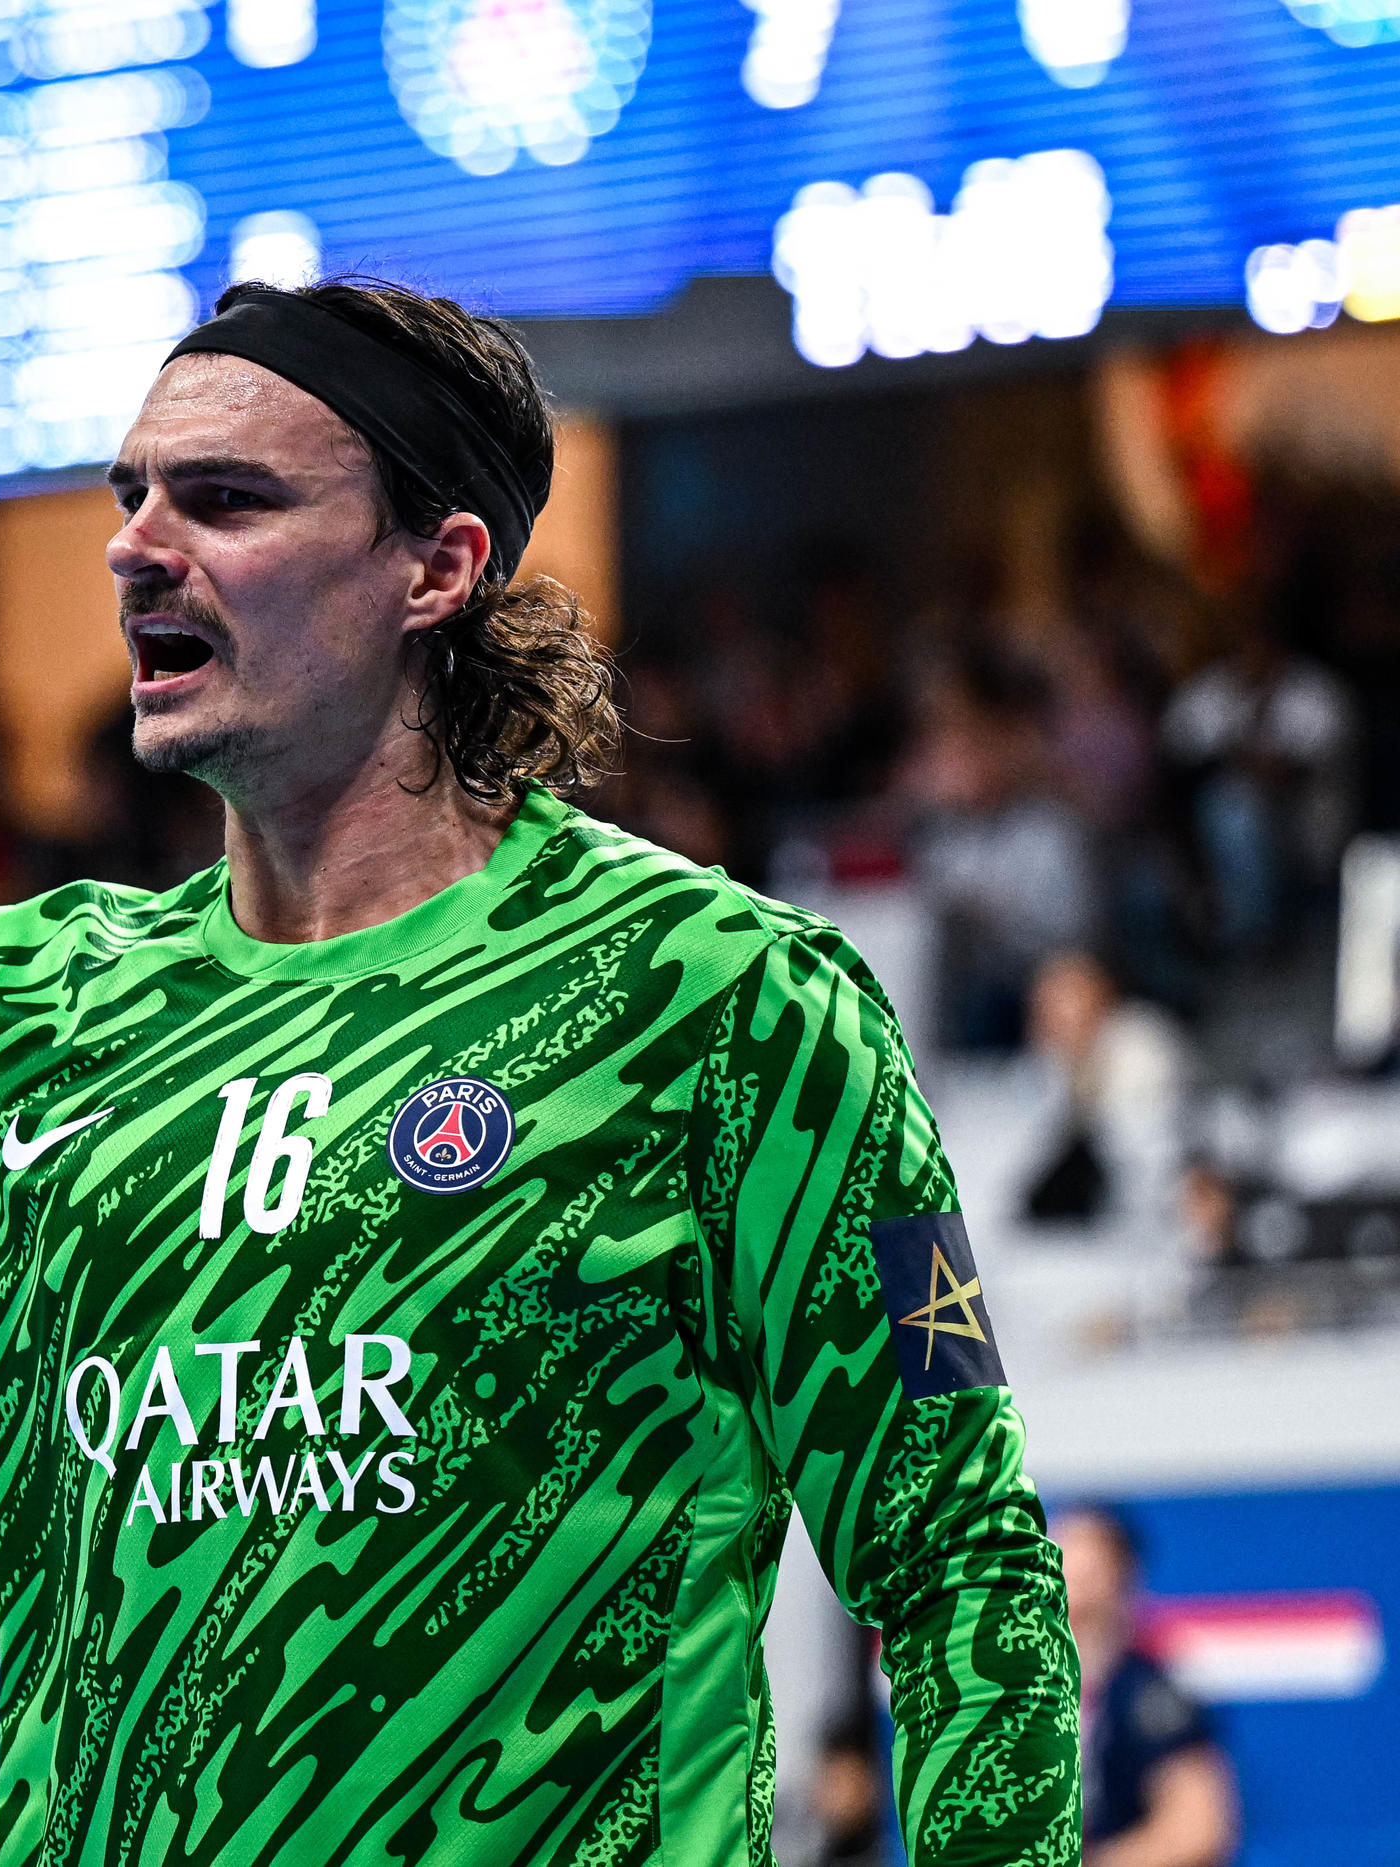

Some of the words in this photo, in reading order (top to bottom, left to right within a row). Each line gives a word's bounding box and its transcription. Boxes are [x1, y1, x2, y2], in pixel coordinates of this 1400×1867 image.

[421, 1084, 498, 1115] PARIS
[199, 1072, 333, 1239] 16
[403, 1154, 427, 1177] SAINT
[434, 1164, 481, 1182] GERMAIN
[64, 1333, 419, 1477] QATAR
[126, 1451, 417, 1527] AIRWAYS
